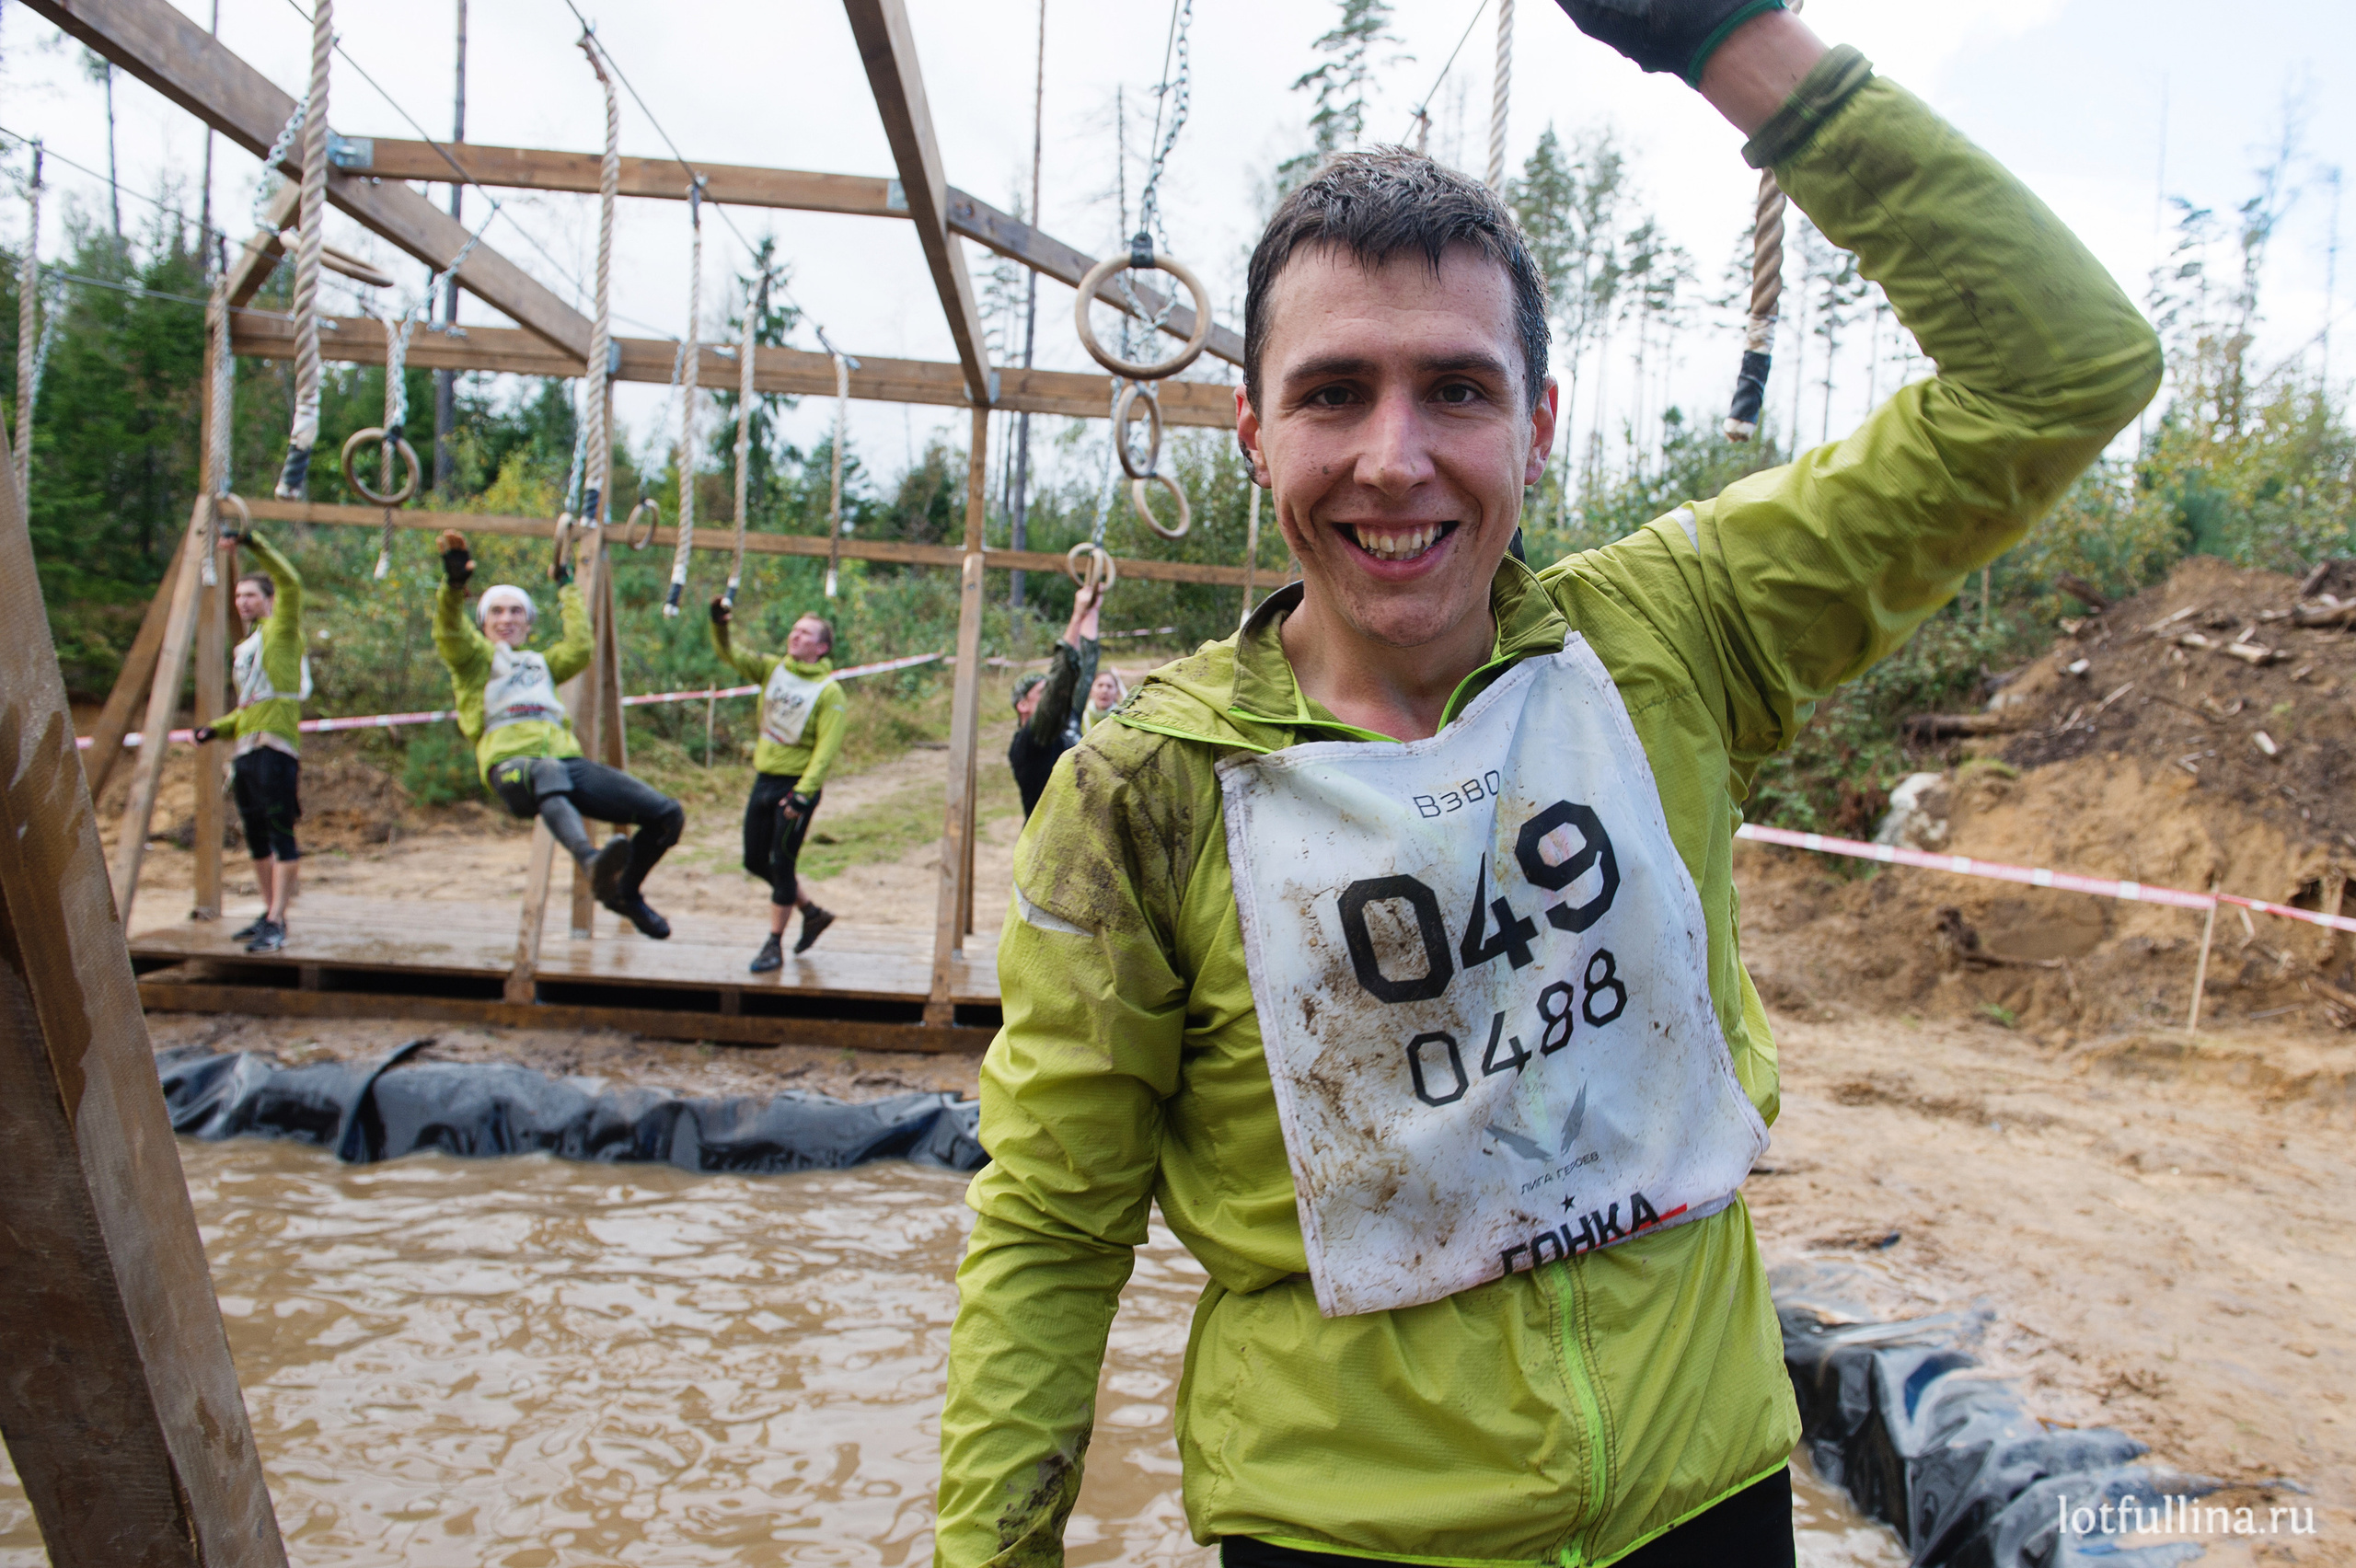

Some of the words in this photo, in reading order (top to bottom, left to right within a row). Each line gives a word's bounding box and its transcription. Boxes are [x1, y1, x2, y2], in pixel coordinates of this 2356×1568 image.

[1412, 769, 1501, 819] ВЗВО
[1336, 799, 1621, 1004] 049
[1405, 947, 1628, 1108] 0488
[1520, 1172, 1553, 1195] ЛИГА
[1556, 1150, 1600, 1179] ГЕРОЕВ
[1500, 1191, 1660, 1276] ГОНКА
